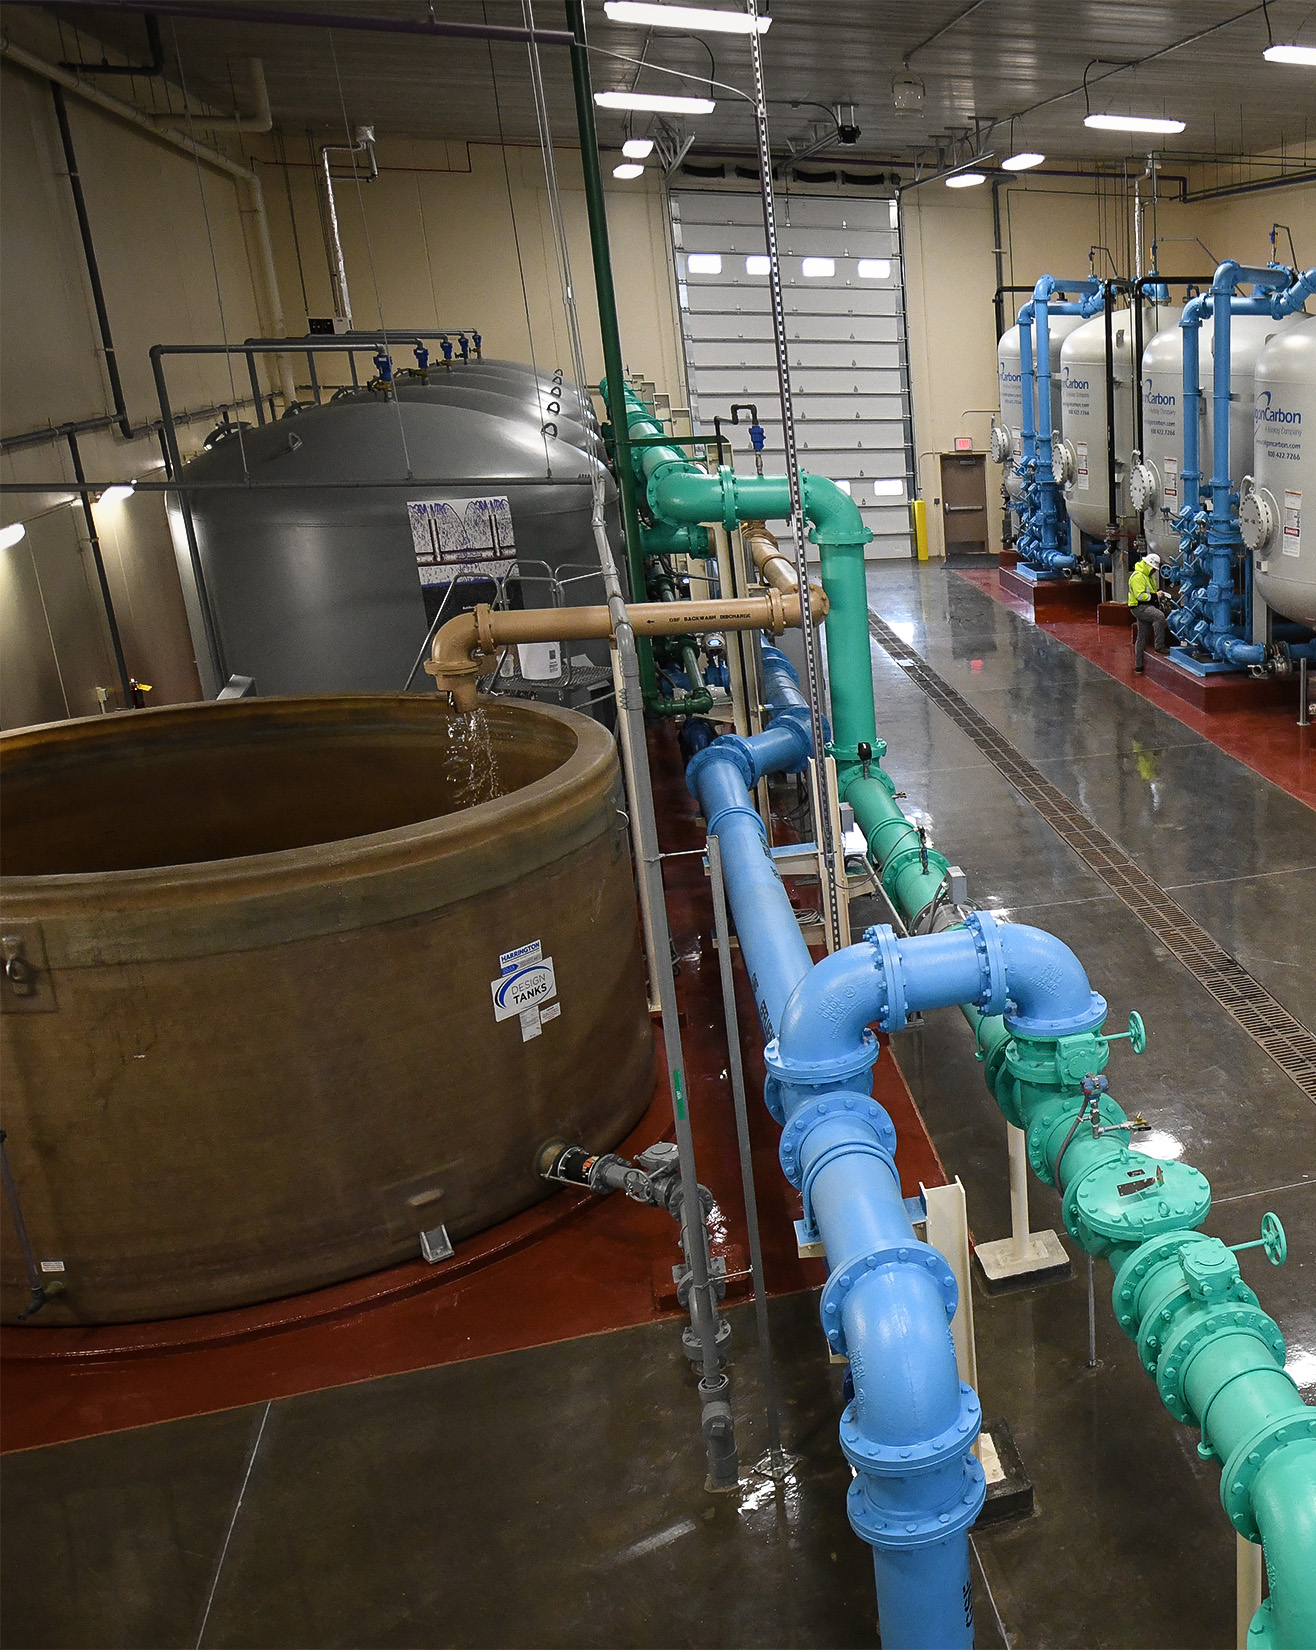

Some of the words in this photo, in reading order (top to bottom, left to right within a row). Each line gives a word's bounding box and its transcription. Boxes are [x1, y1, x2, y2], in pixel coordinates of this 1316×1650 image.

[501, 941, 540, 962] HARRINGTON
[511, 973, 546, 995] DESIGN
[513, 983, 547, 1004] TANKS
